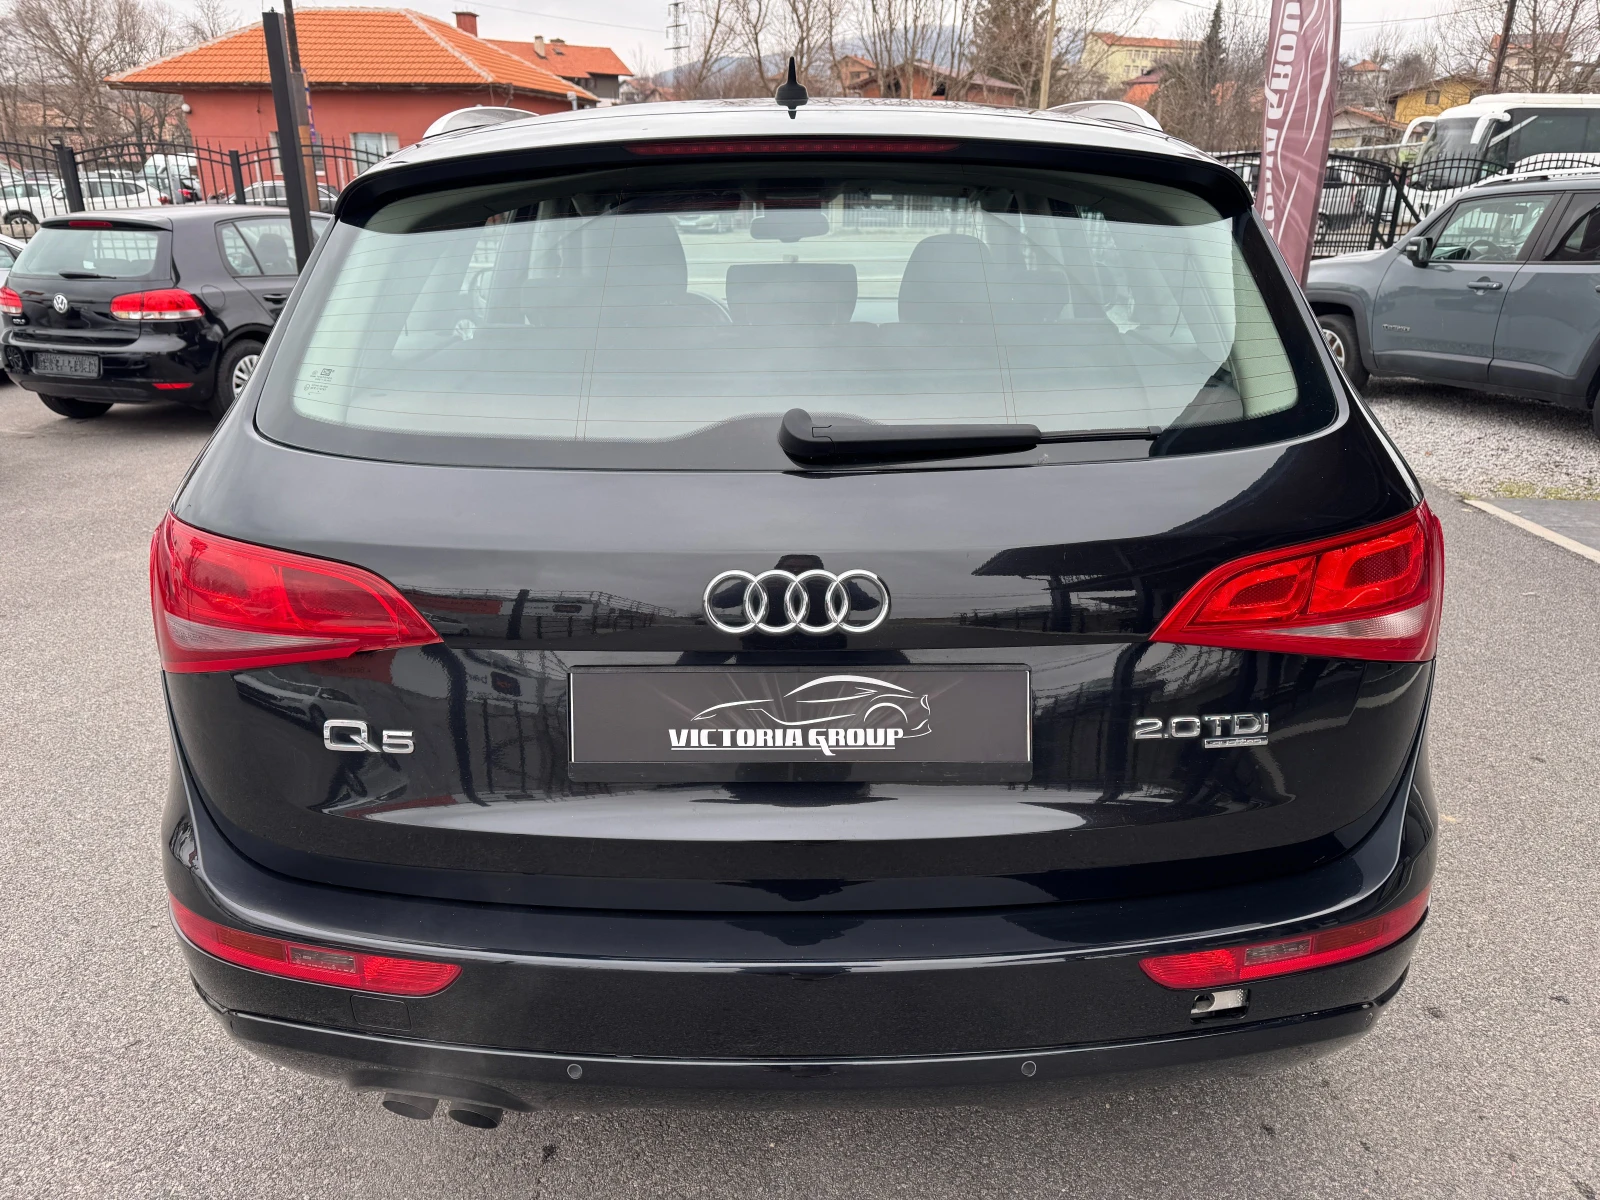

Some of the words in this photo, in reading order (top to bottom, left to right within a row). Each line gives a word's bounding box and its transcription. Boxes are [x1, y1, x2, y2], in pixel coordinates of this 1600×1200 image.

[323, 719, 415, 754] Q5
[669, 728, 803, 747] VICTORIA
[808, 728, 904, 756] GROUP
